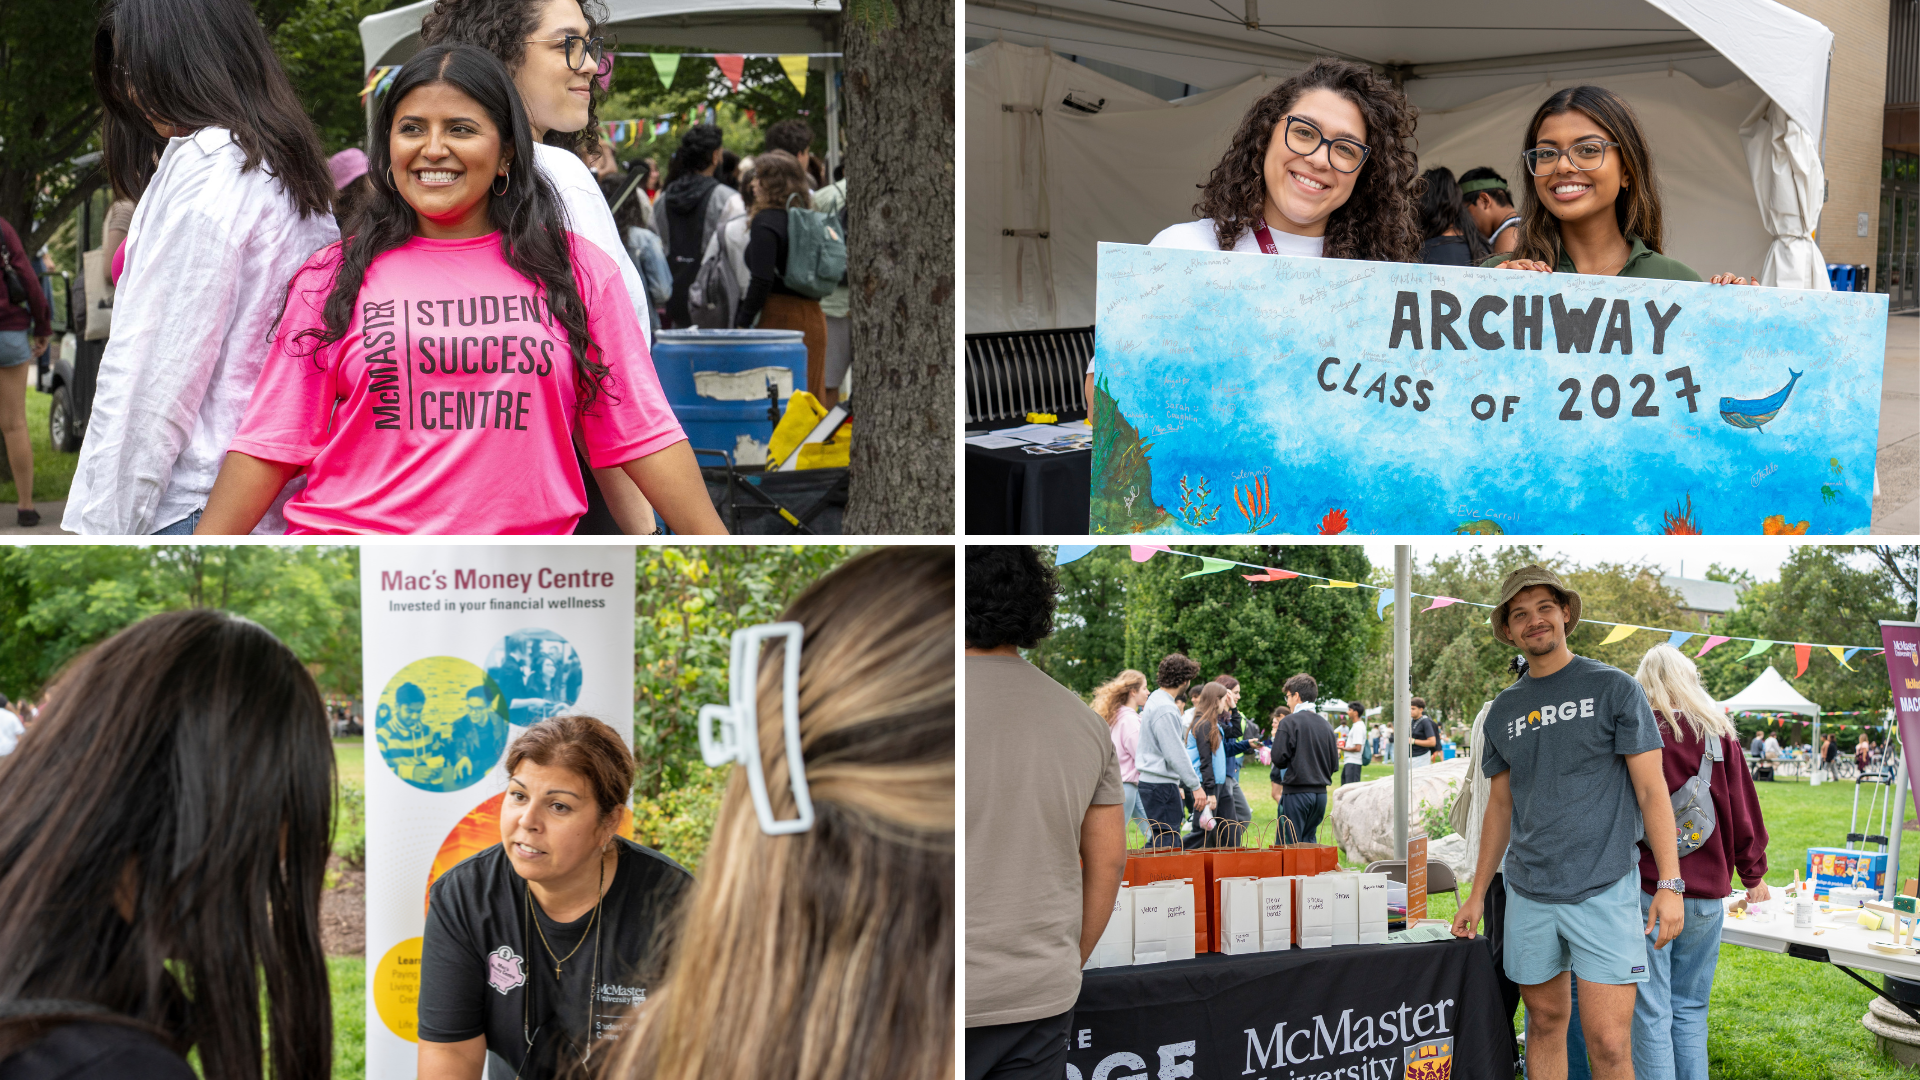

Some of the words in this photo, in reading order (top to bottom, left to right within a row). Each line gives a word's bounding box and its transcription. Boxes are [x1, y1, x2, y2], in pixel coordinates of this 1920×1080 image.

[1389, 290, 1682, 355] ARCHWAY
[362, 299, 401, 430] McMASTER
[418, 336, 555, 377] SUCCESS
[1316, 357, 1434, 412] CLASS
[1471, 394, 1520, 421] OF
[1558, 365, 1701, 421] 2027
[420, 390, 531, 431] CENTRE
[1165, 400, 1190, 412] Sarah
[1457, 504, 1481, 518] Eve
[1485, 508, 1520, 522] Carroll
[381, 569, 448, 591] Mac's
[454, 568, 533, 594] Money
[538, 567, 614, 589] Centre
[389, 599, 441, 612] Invested
[444, 599, 456, 611] in
[459, 601, 487, 614] your
[489, 597, 544, 610] financial
[547, 597, 606, 609] wellness
[1893, 640, 1917, 651] McMaster
[390, 982, 413, 993] Living
[596, 982, 646, 997] McMaster
[1241, 998, 1455, 1076] McMaster
